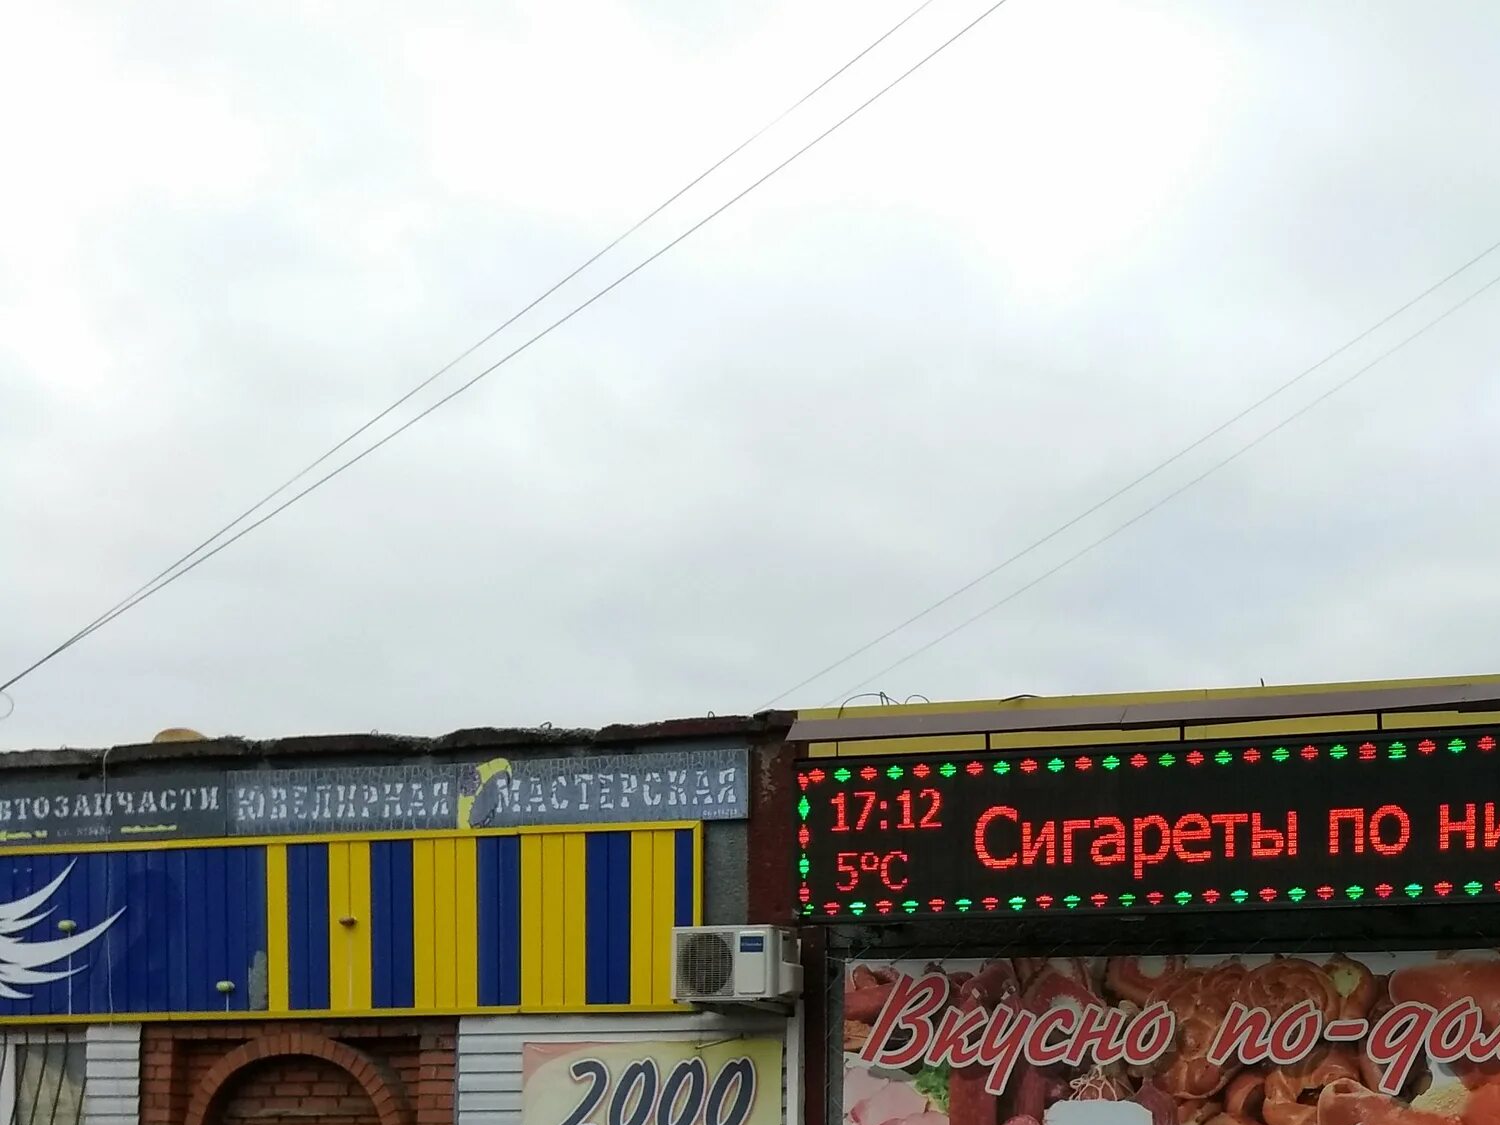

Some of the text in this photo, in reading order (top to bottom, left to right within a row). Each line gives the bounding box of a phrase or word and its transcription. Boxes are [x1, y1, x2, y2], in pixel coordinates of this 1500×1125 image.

[237, 767, 737, 821] ЮВЕЛИРНАЯ МАСТЕРСКАЯ
[830, 788, 943, 831] 17:12
[975, 805, 1298, 879] Сигареты
[1329, 803, 1411, 856] по
[858, 970, 1176, 1095] Вкусно
